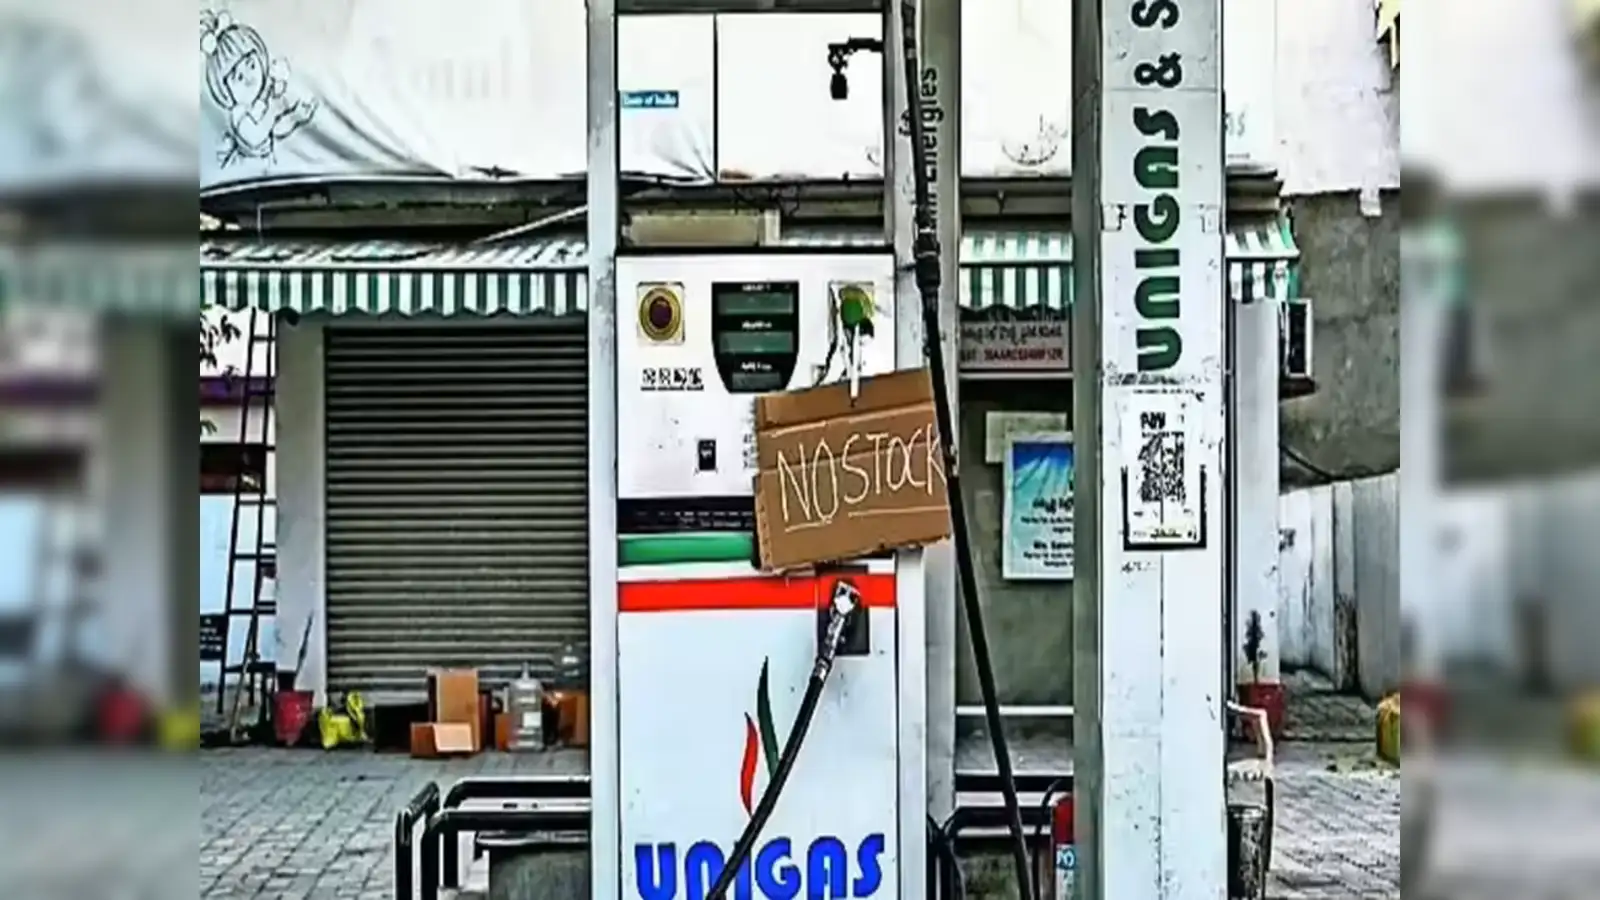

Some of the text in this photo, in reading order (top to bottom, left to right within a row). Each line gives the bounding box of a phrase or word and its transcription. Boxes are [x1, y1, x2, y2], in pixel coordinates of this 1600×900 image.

[1134, 52, 1182, 88] &
[1133, 107, 1182, 371] UNIGAS
[777, 438, 840, 523] NO
[842, 423, 948, 504] STOCK
[634, 833, 885, 900] UNIGAS
